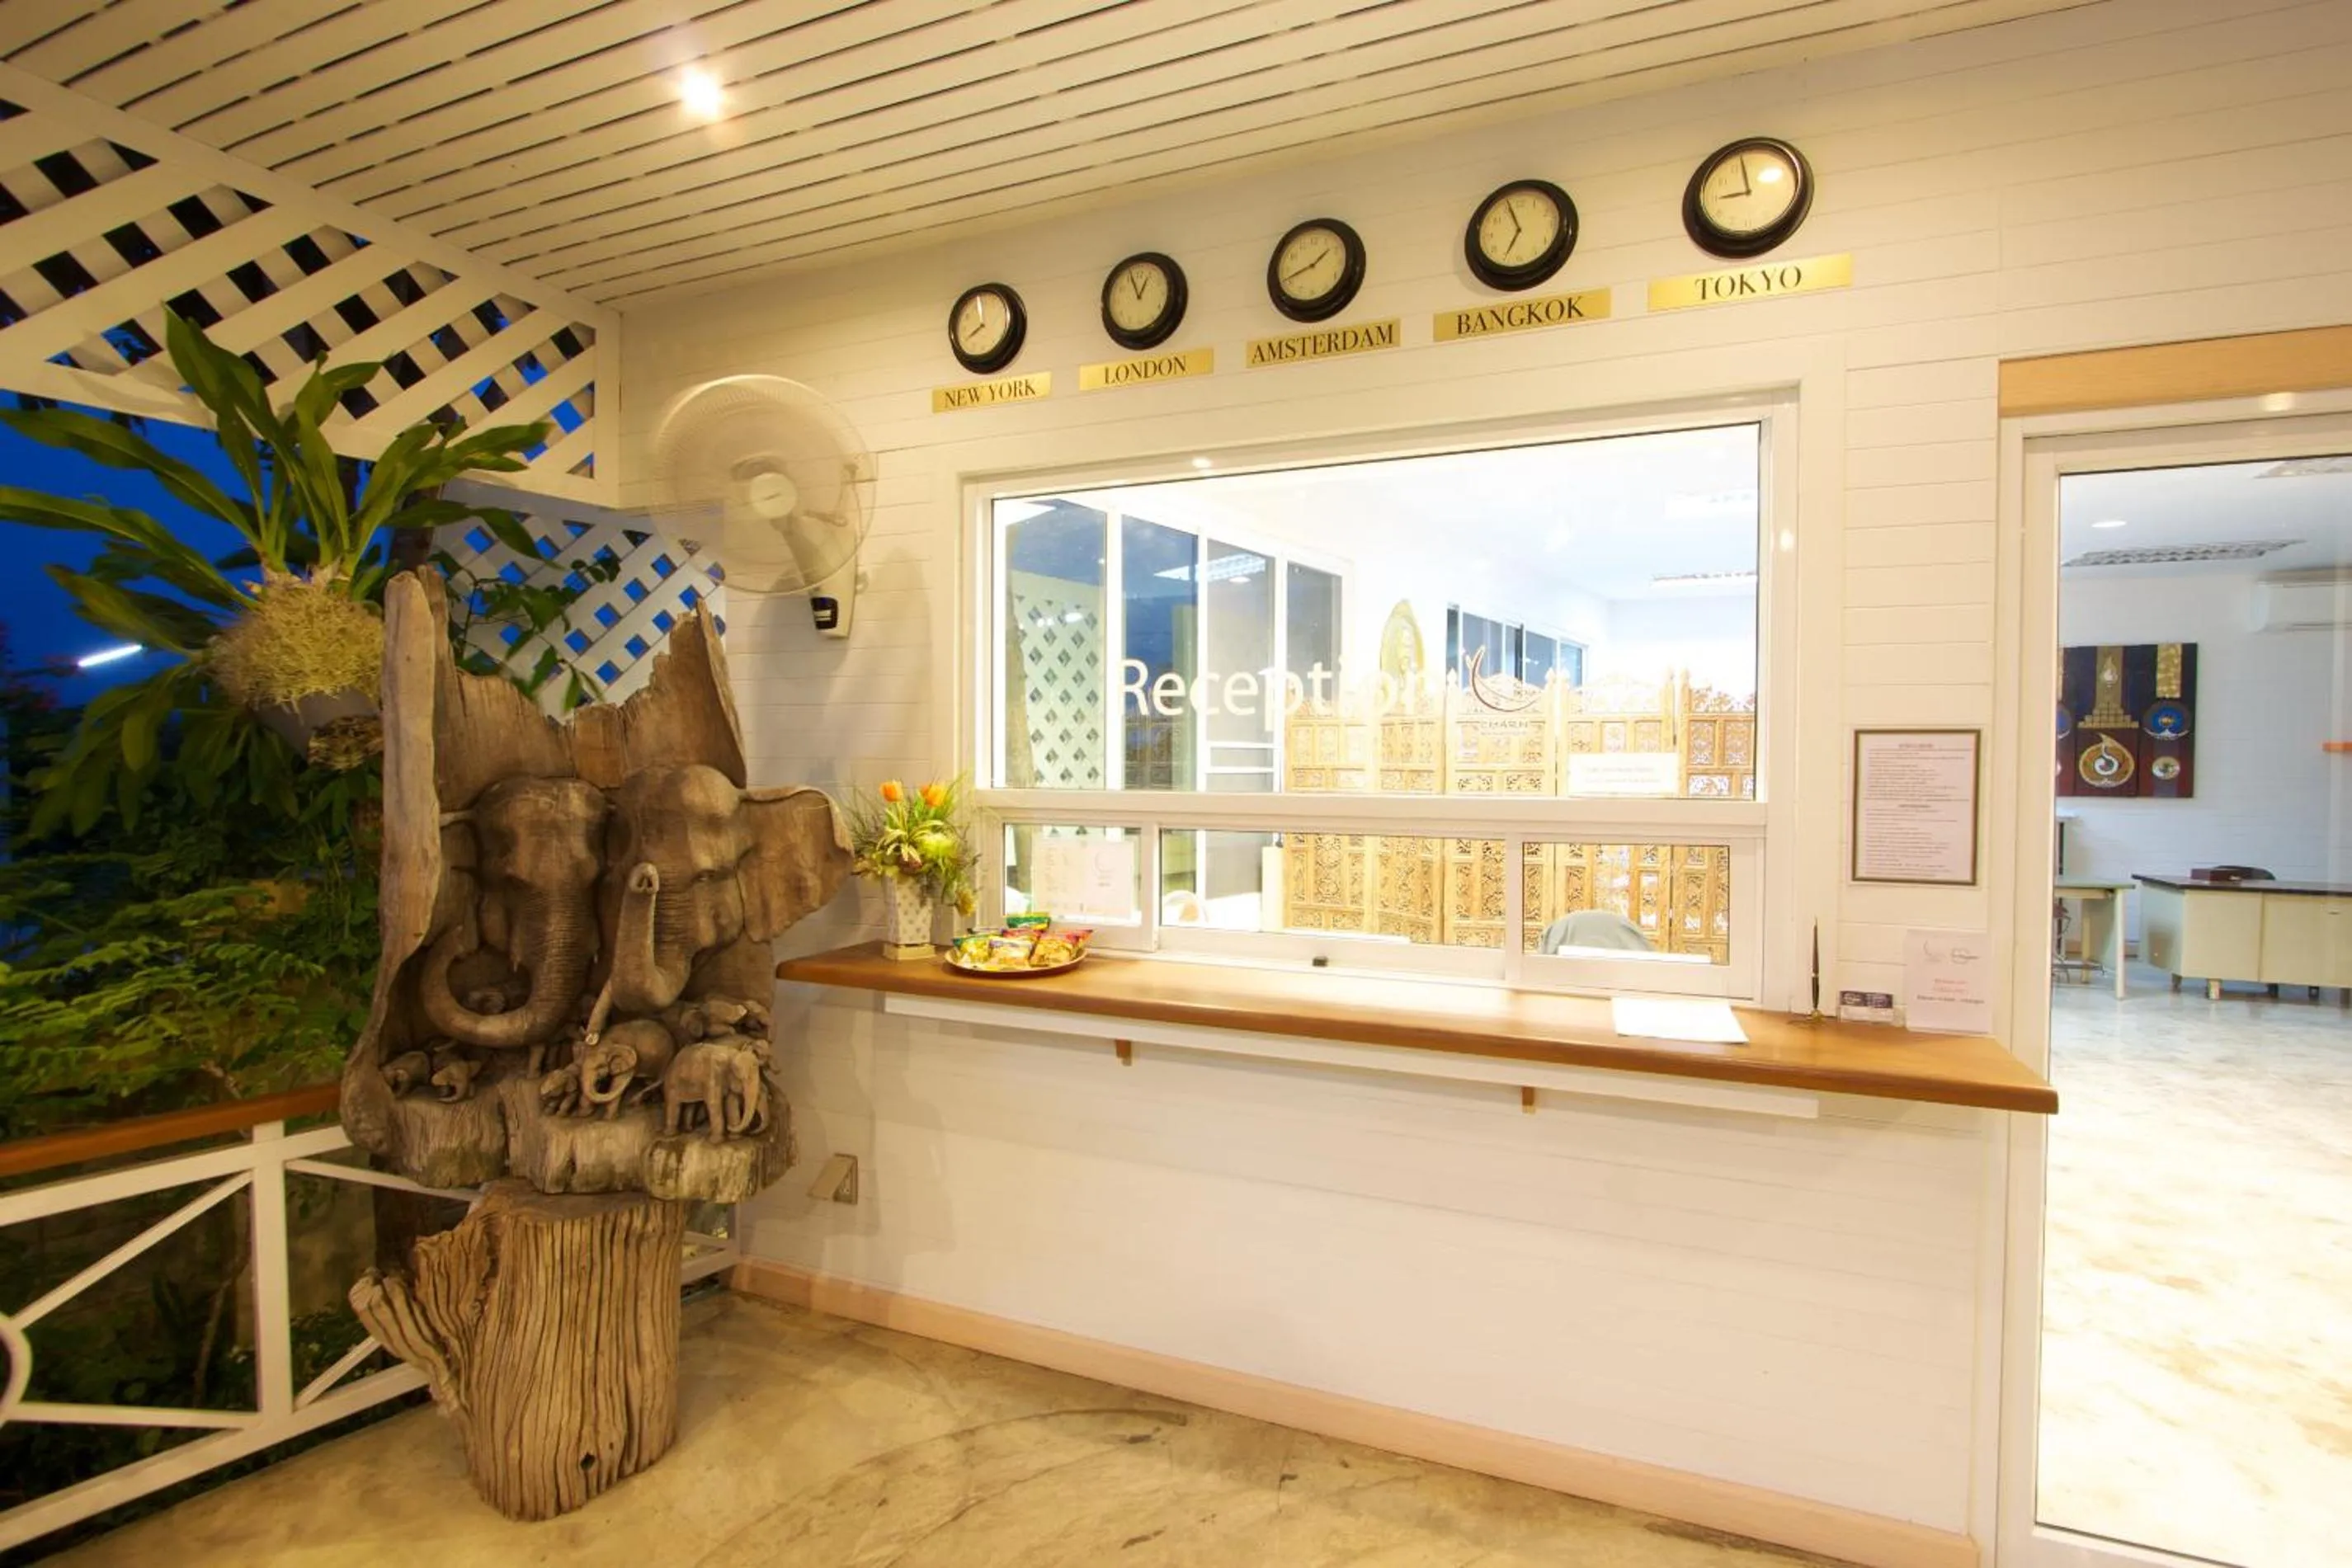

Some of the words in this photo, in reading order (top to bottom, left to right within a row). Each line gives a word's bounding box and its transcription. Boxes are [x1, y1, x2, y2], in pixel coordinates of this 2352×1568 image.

[1694, 266, 1802, 300] TOKYO
[1457, 295, 1584, 334] BANGKOK
[1251, 324, 1393, 364] AMSTERDAM
[1104, 355, 1186, 384] LONDON
[945, 386, 983, 407] NEW
[988, 379, 1036, 401] YORK
[1119, 657, 1440, 732] Reception
